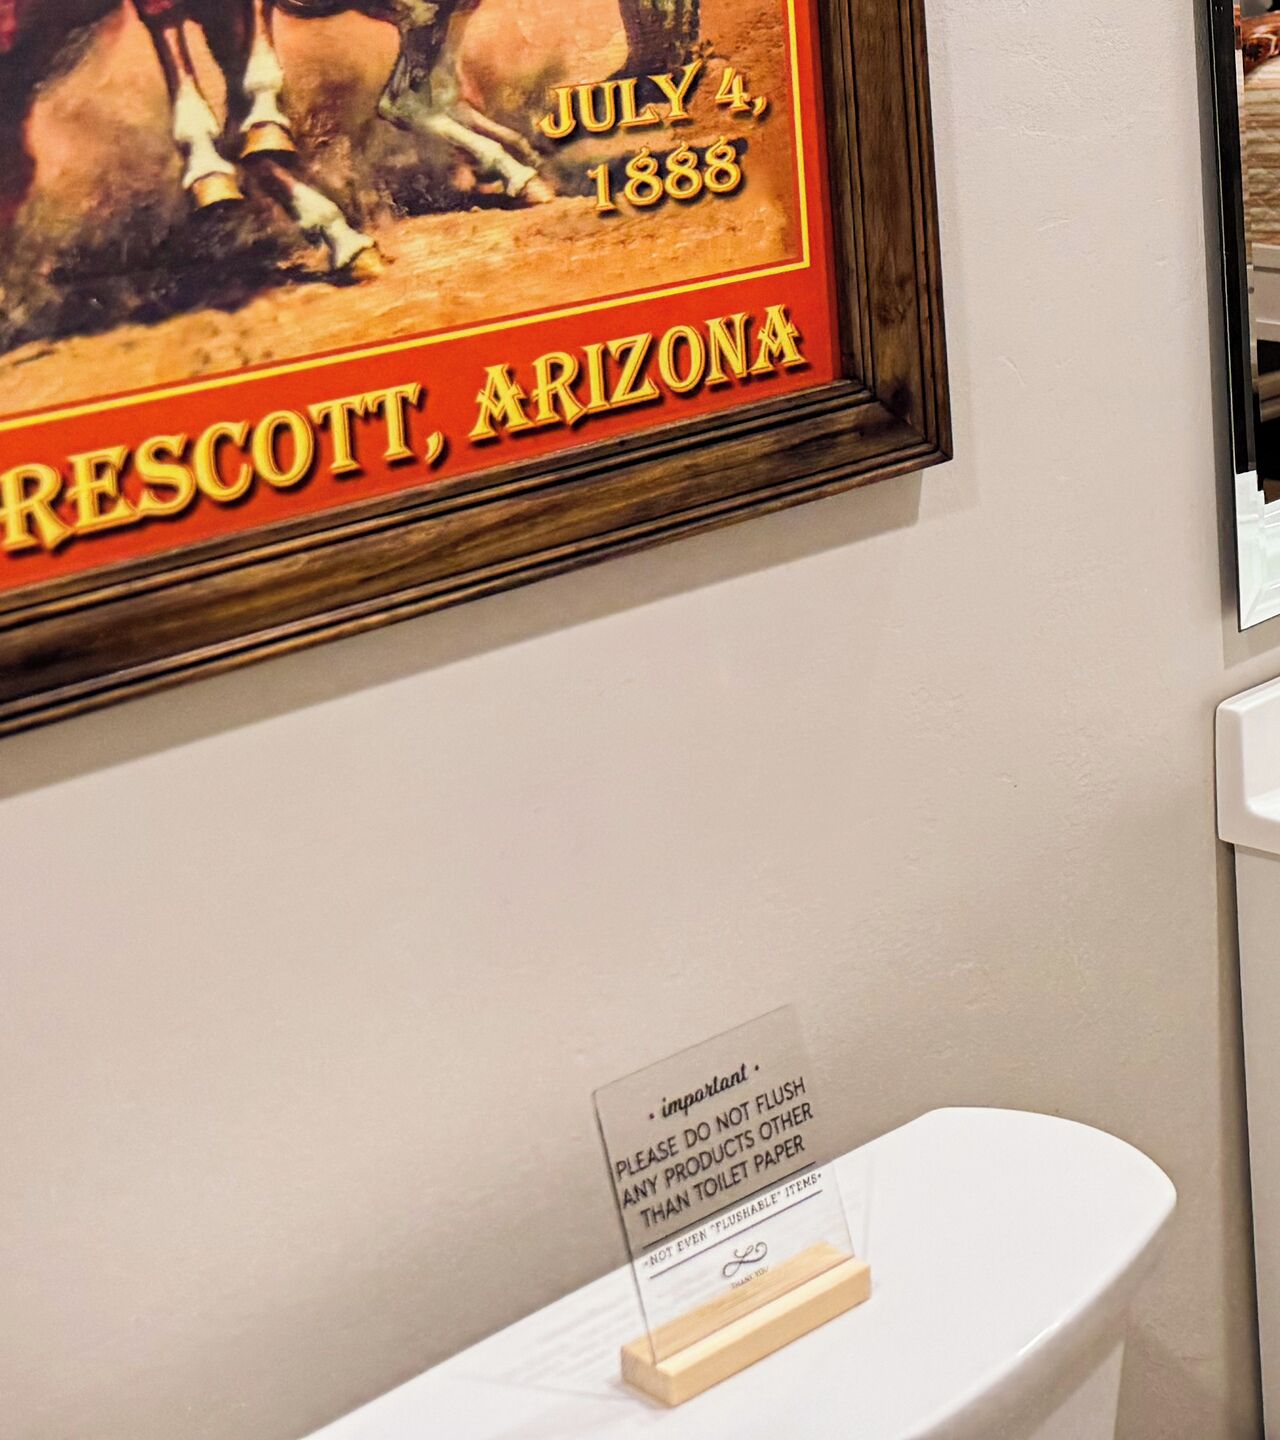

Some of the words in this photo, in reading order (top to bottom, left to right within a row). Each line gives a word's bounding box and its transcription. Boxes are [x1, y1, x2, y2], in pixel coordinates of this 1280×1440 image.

[539, 59, 702, 138] JULY
[715, 67, 767, 116] 4,
[587, 136, 741, 211] 1888
[471, 304, 806, 444] ARIZONA
[615, 1135, 679, 1181] PLEASE
[684, 1122, 711, 1149] DO
[716, 1101, 751, 1133] NOT
[755, 1076, 807, 1114] FLUSH
[661, 1063, 749, 1118] important
[622, 1176, 657, 1209] ANY
[665, 1130, 755, 1188] PRODUCTS
[759, 1102, 814, 1141] OTHER
[640, 1189, 691, 1228] THAN
[693, 1160, 750, 1200] TOILET
[754, 1135, 806, 1173] PAPER
[678, 1230, 708, 1252] EVEN
